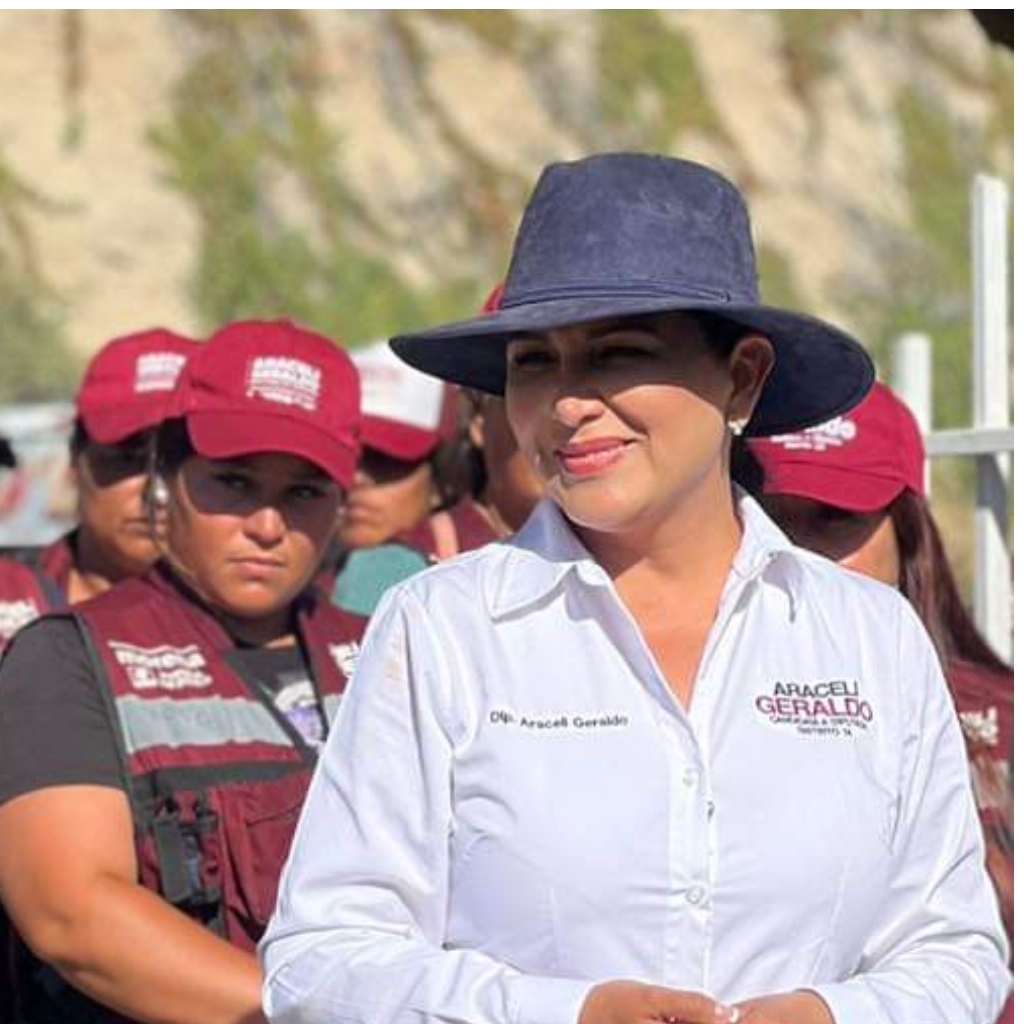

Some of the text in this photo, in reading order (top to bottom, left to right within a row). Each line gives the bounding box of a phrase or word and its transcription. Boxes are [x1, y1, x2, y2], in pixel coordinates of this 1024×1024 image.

[774, 680, 859, 698] ARACELI
[756, 695, 873, 721] GERALDO
[520, 717, 568, 729] Araceli
[573, 715, 629, 728] Geraldo
